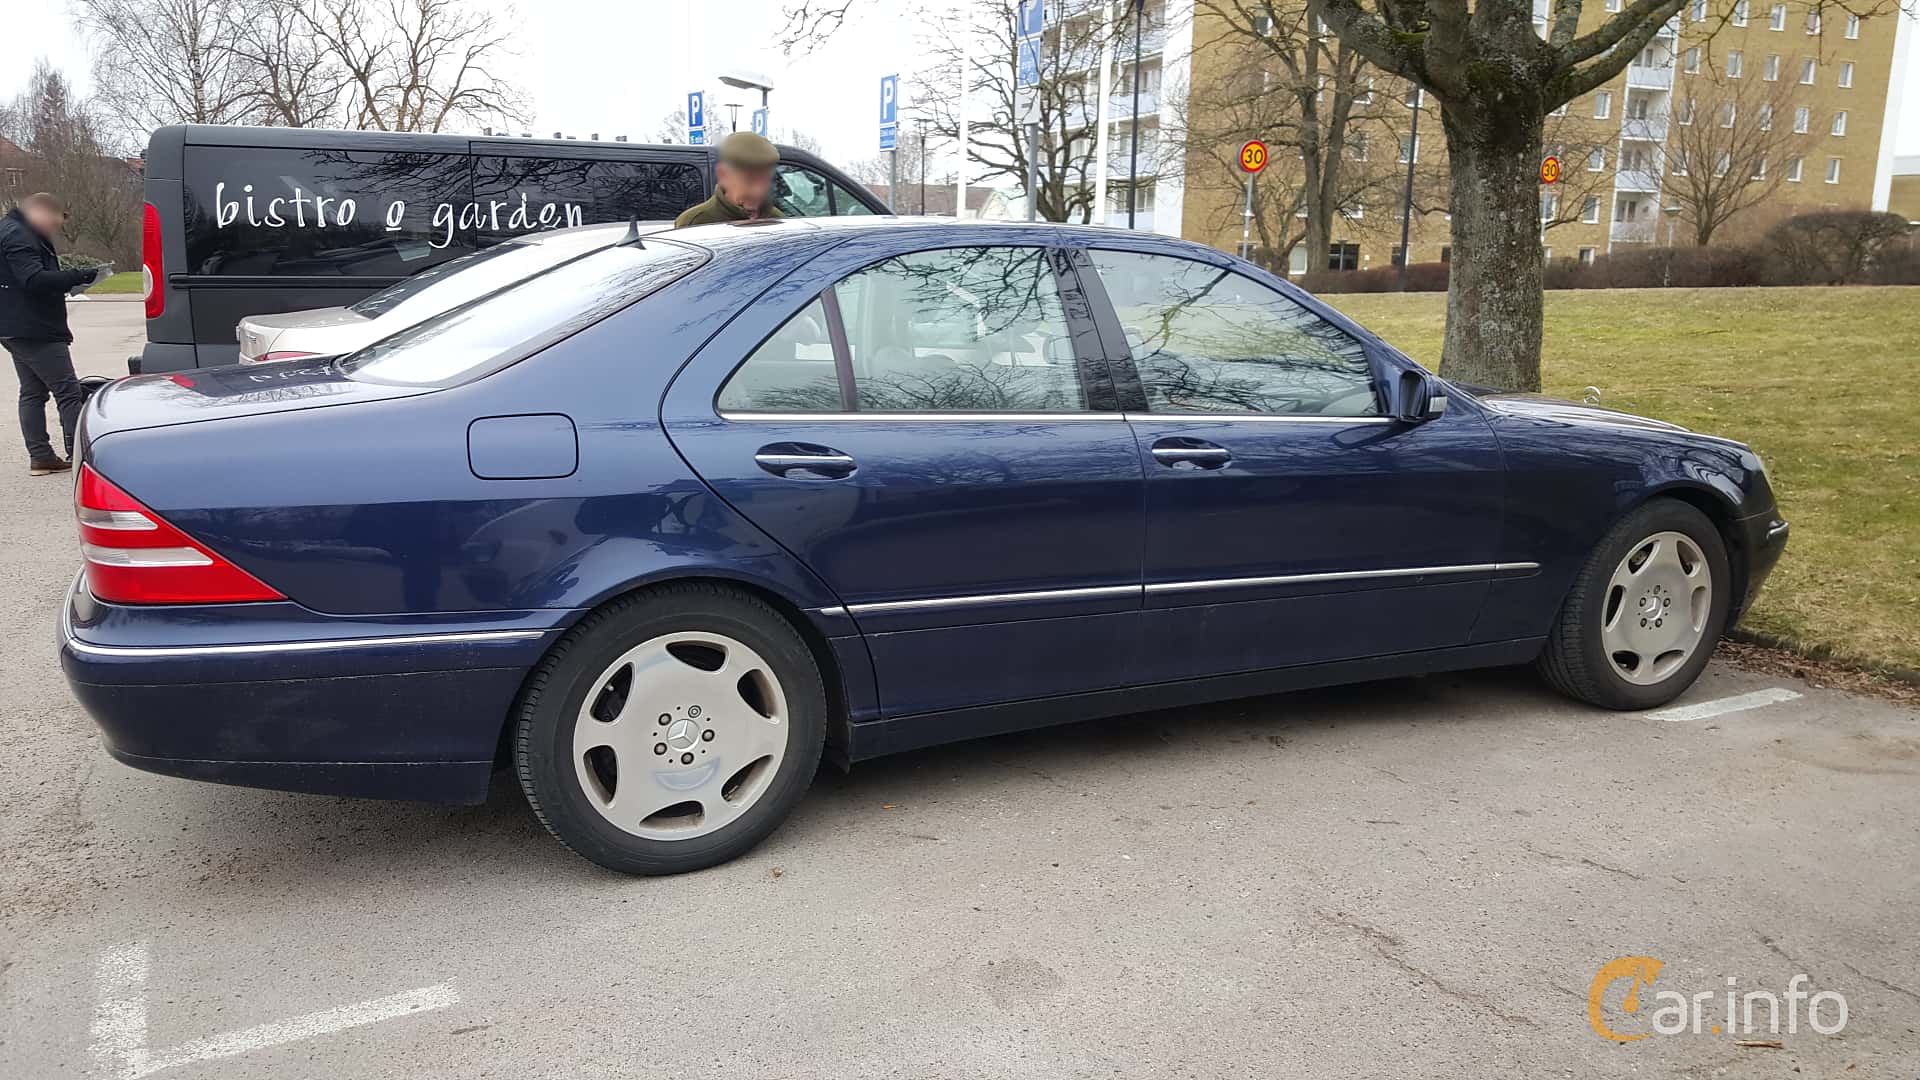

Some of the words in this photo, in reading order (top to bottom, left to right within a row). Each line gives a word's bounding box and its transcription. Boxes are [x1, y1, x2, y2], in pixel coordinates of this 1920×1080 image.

[691, 95, 700, 125] P
[883, 80, 894, 120] P
[1244, 148, 1264, 165] 30
[1543, 163, 1557, 177] 30
[215, 182, 356, 229] bistro
[428, 192, 583, 249] garden
